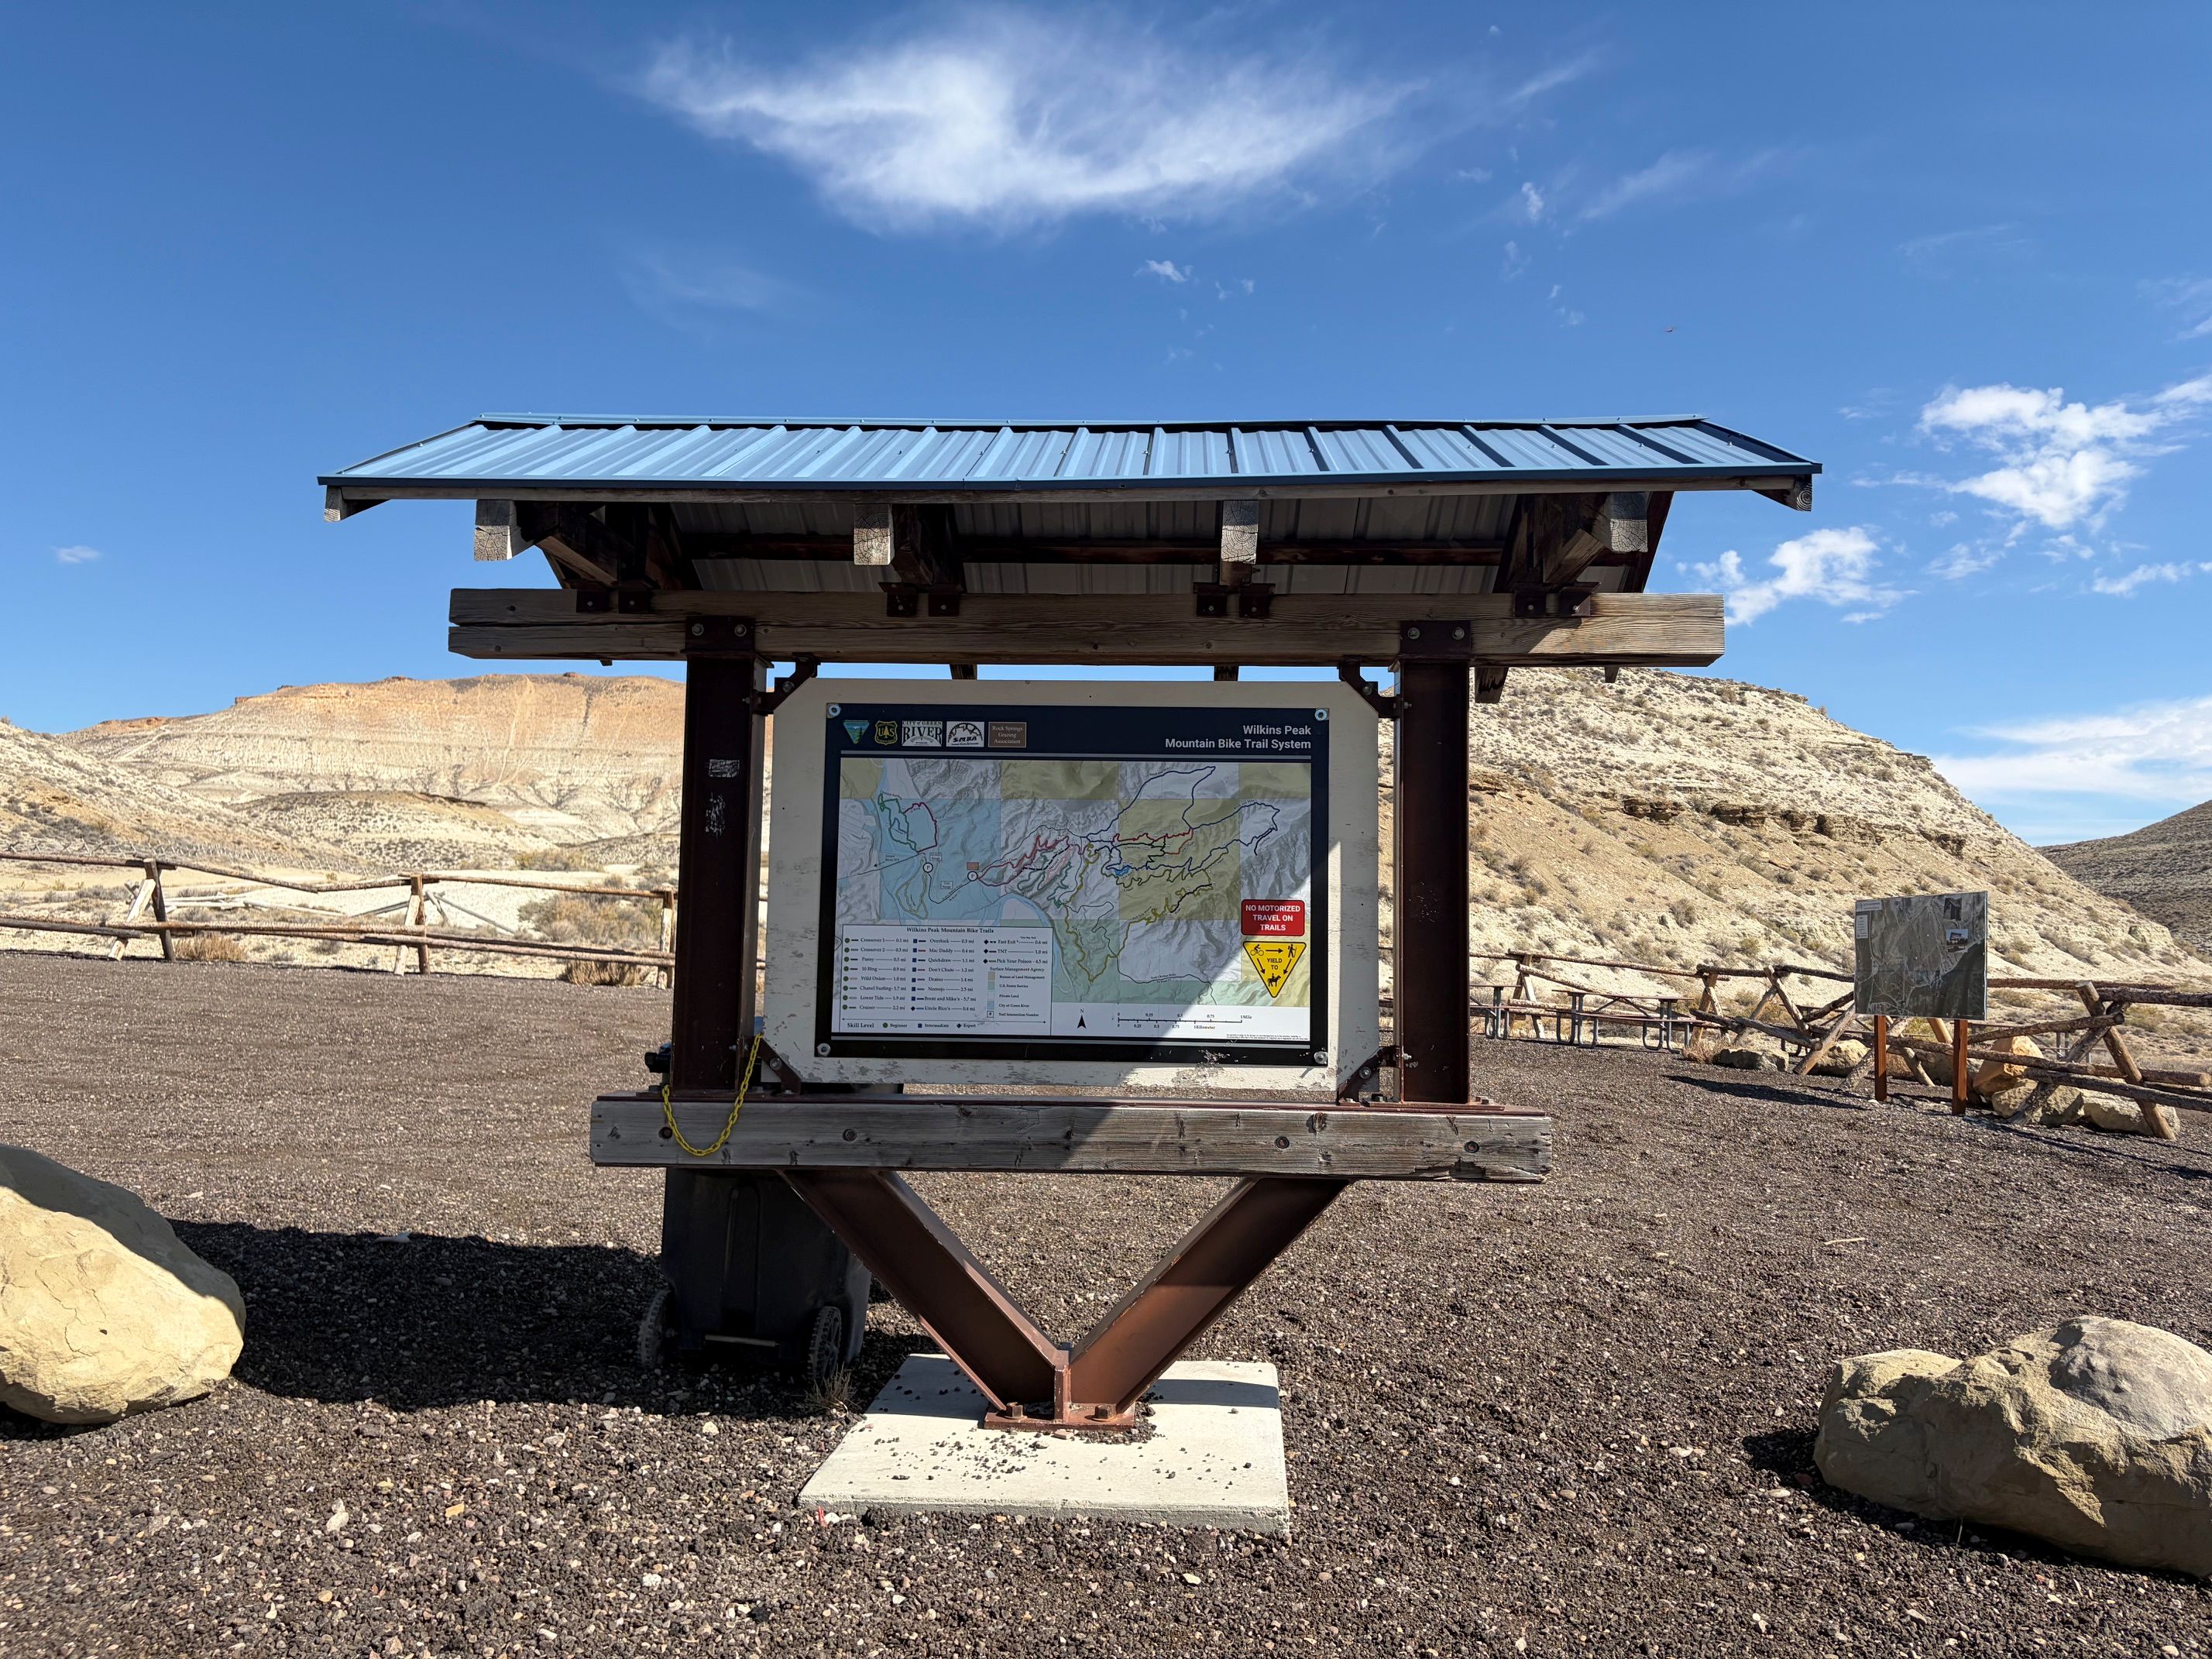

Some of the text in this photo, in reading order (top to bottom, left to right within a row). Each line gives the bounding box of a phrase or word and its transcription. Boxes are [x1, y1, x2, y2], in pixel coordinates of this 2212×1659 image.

[902, 726, 942, 744] RIVER
[1243, 725, 1311, 735] Wilkins Peak
[1165, 738, 1311, 750] Mountain Bike Trail System
